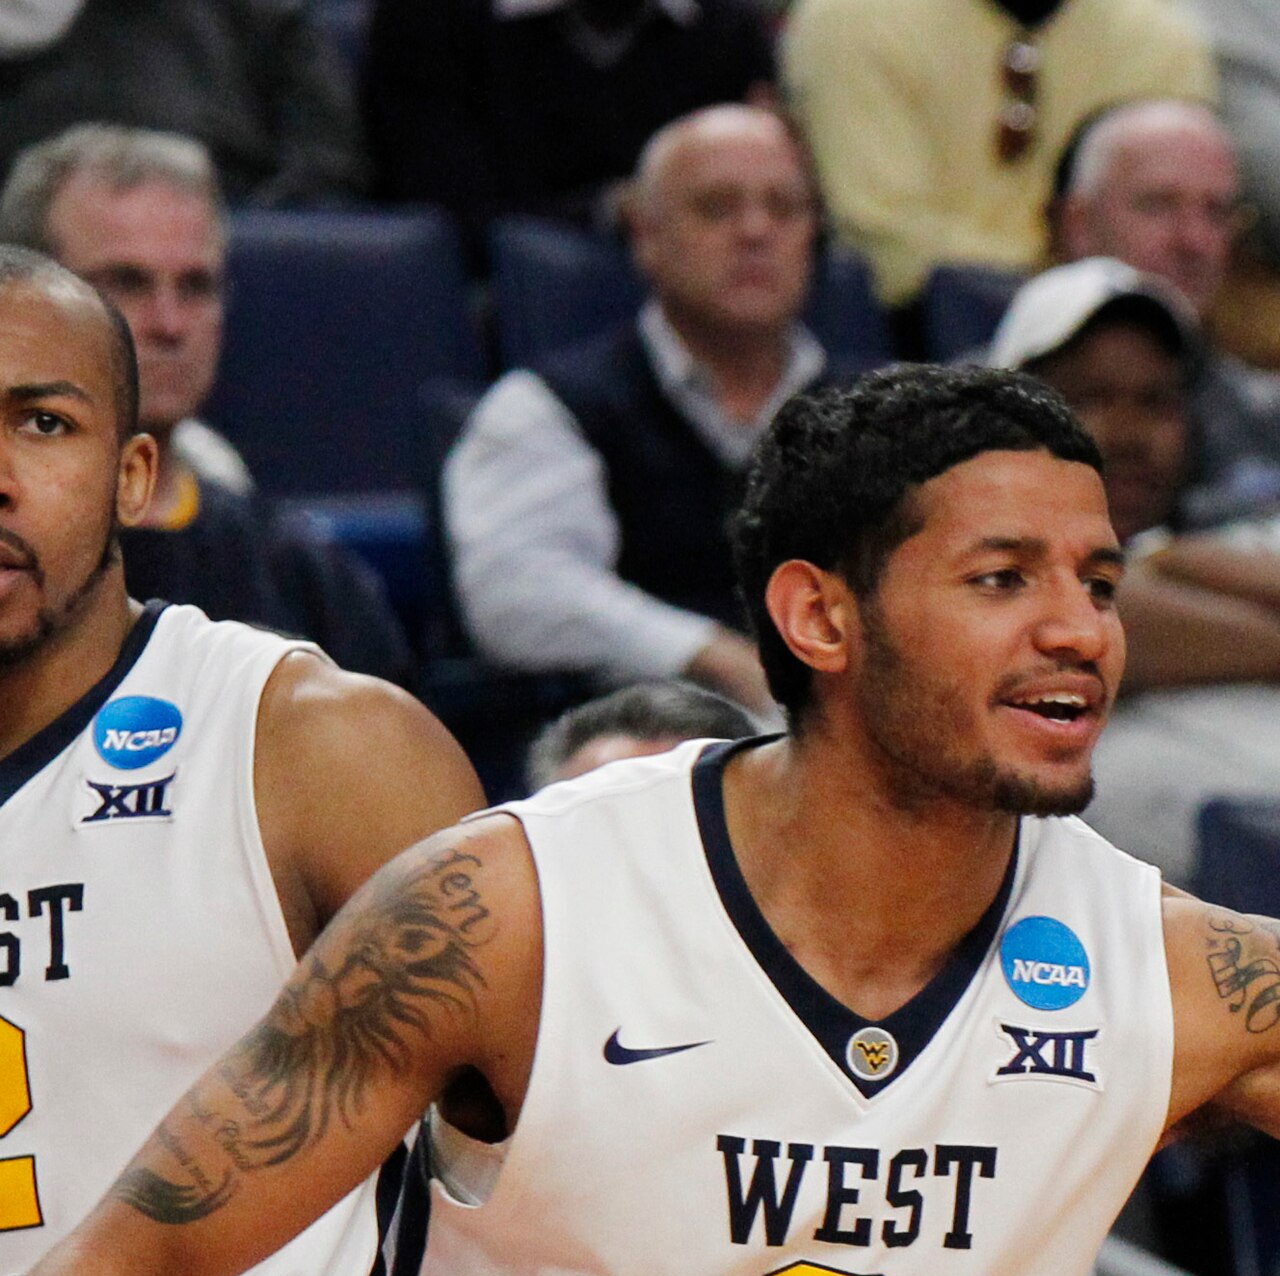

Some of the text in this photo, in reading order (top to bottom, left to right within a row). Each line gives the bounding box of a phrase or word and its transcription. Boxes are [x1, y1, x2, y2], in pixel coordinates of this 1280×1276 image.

[102, 722, 177, 752] NCAA
[81, 771, 176, 823] XII
[1011, 958, 1088, 989] NCAA
[997, 1023, 1100, 1083] XII
[715, 1134, 998, 1250] WEST
